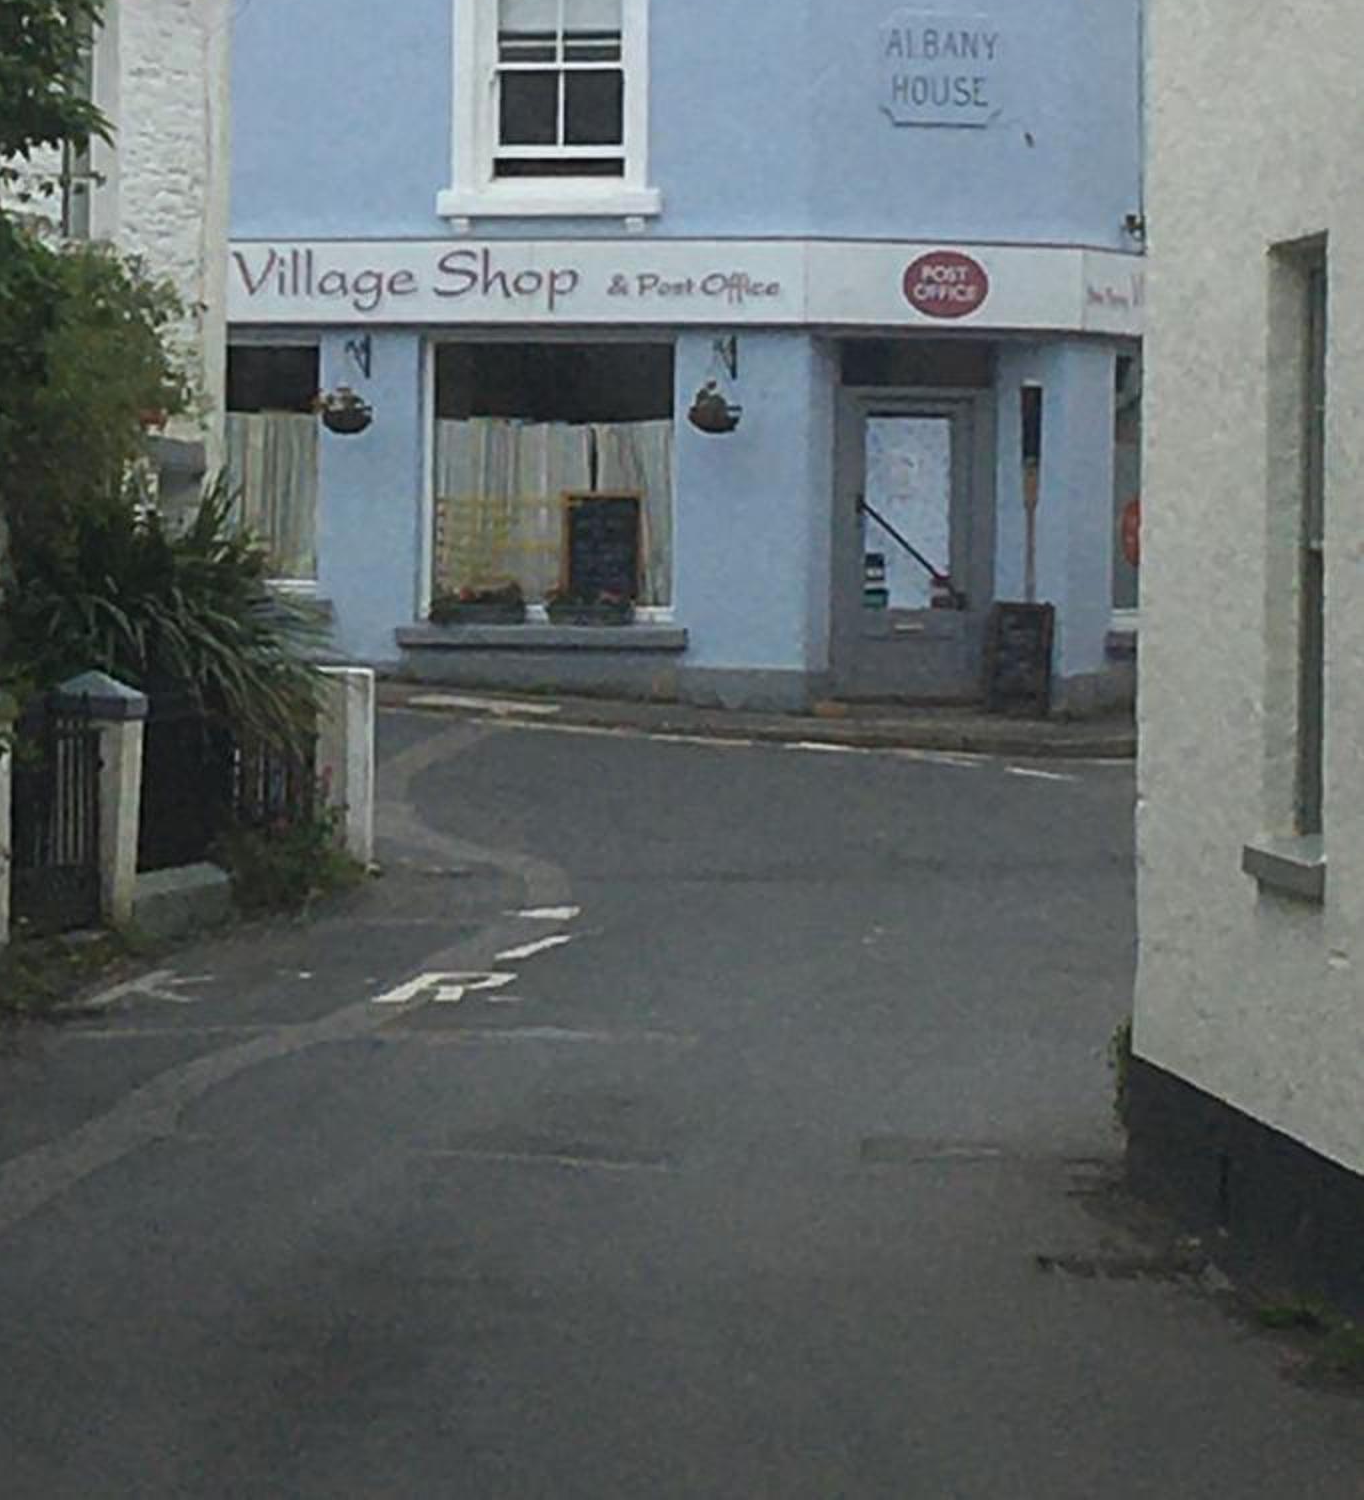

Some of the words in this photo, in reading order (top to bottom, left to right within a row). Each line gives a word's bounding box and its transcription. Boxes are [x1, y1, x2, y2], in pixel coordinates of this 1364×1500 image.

[884, 27, 999, 60] ALBANY
[891, 74, 989, 107] HOUSE
[231, 247, 419, 312] Village
[433, 247, 579, 311] Shop
[606, 273, 629, 297] &
[636, 272, 696, 297] Post
[700, 271, 781, 305] Office
[921, 265, 970, 283] POST
[913, 283, 978, 303] OFFICE
